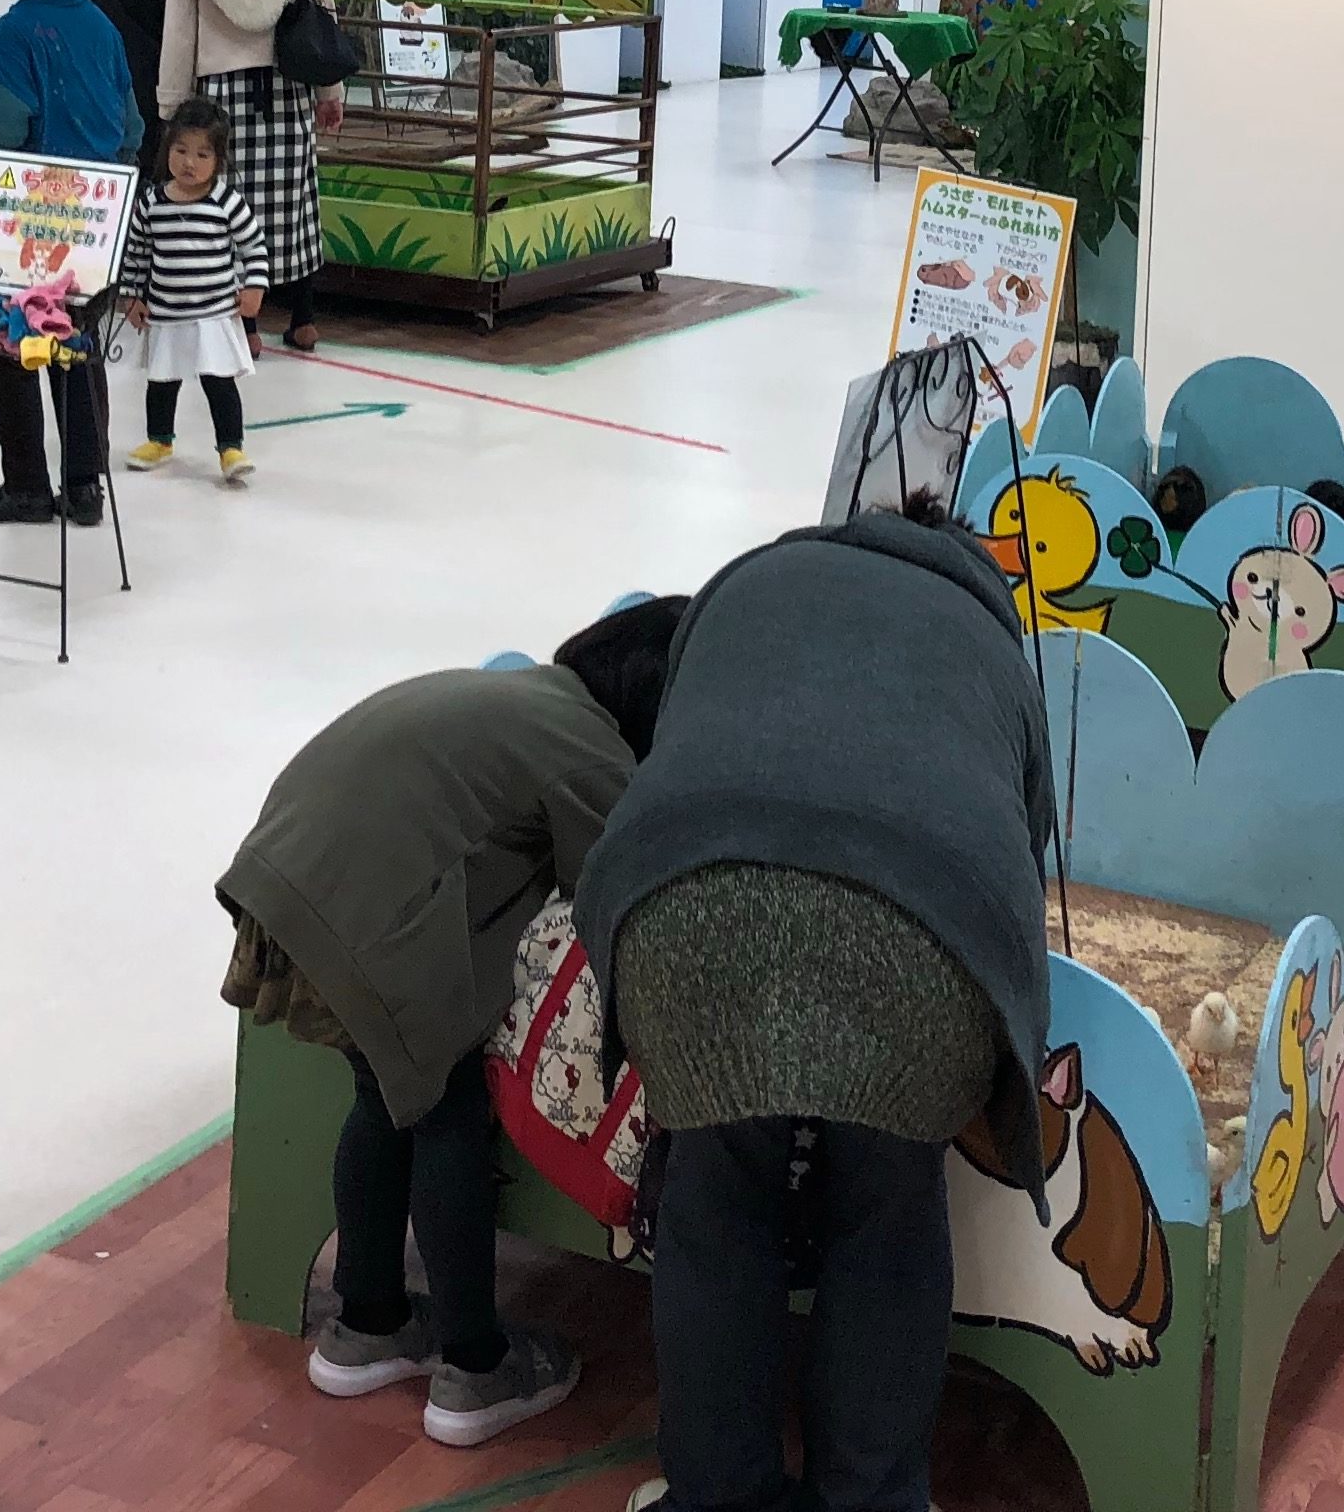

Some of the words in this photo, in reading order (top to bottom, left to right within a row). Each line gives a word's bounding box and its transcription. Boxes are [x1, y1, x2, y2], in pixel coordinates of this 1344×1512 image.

[22, 169, 118, 201] ちゅうい
[938, 184, 1048, 220] うさぎ・モルモット
[920, 198, 1061, 243] ハムスターとのふれあい方
